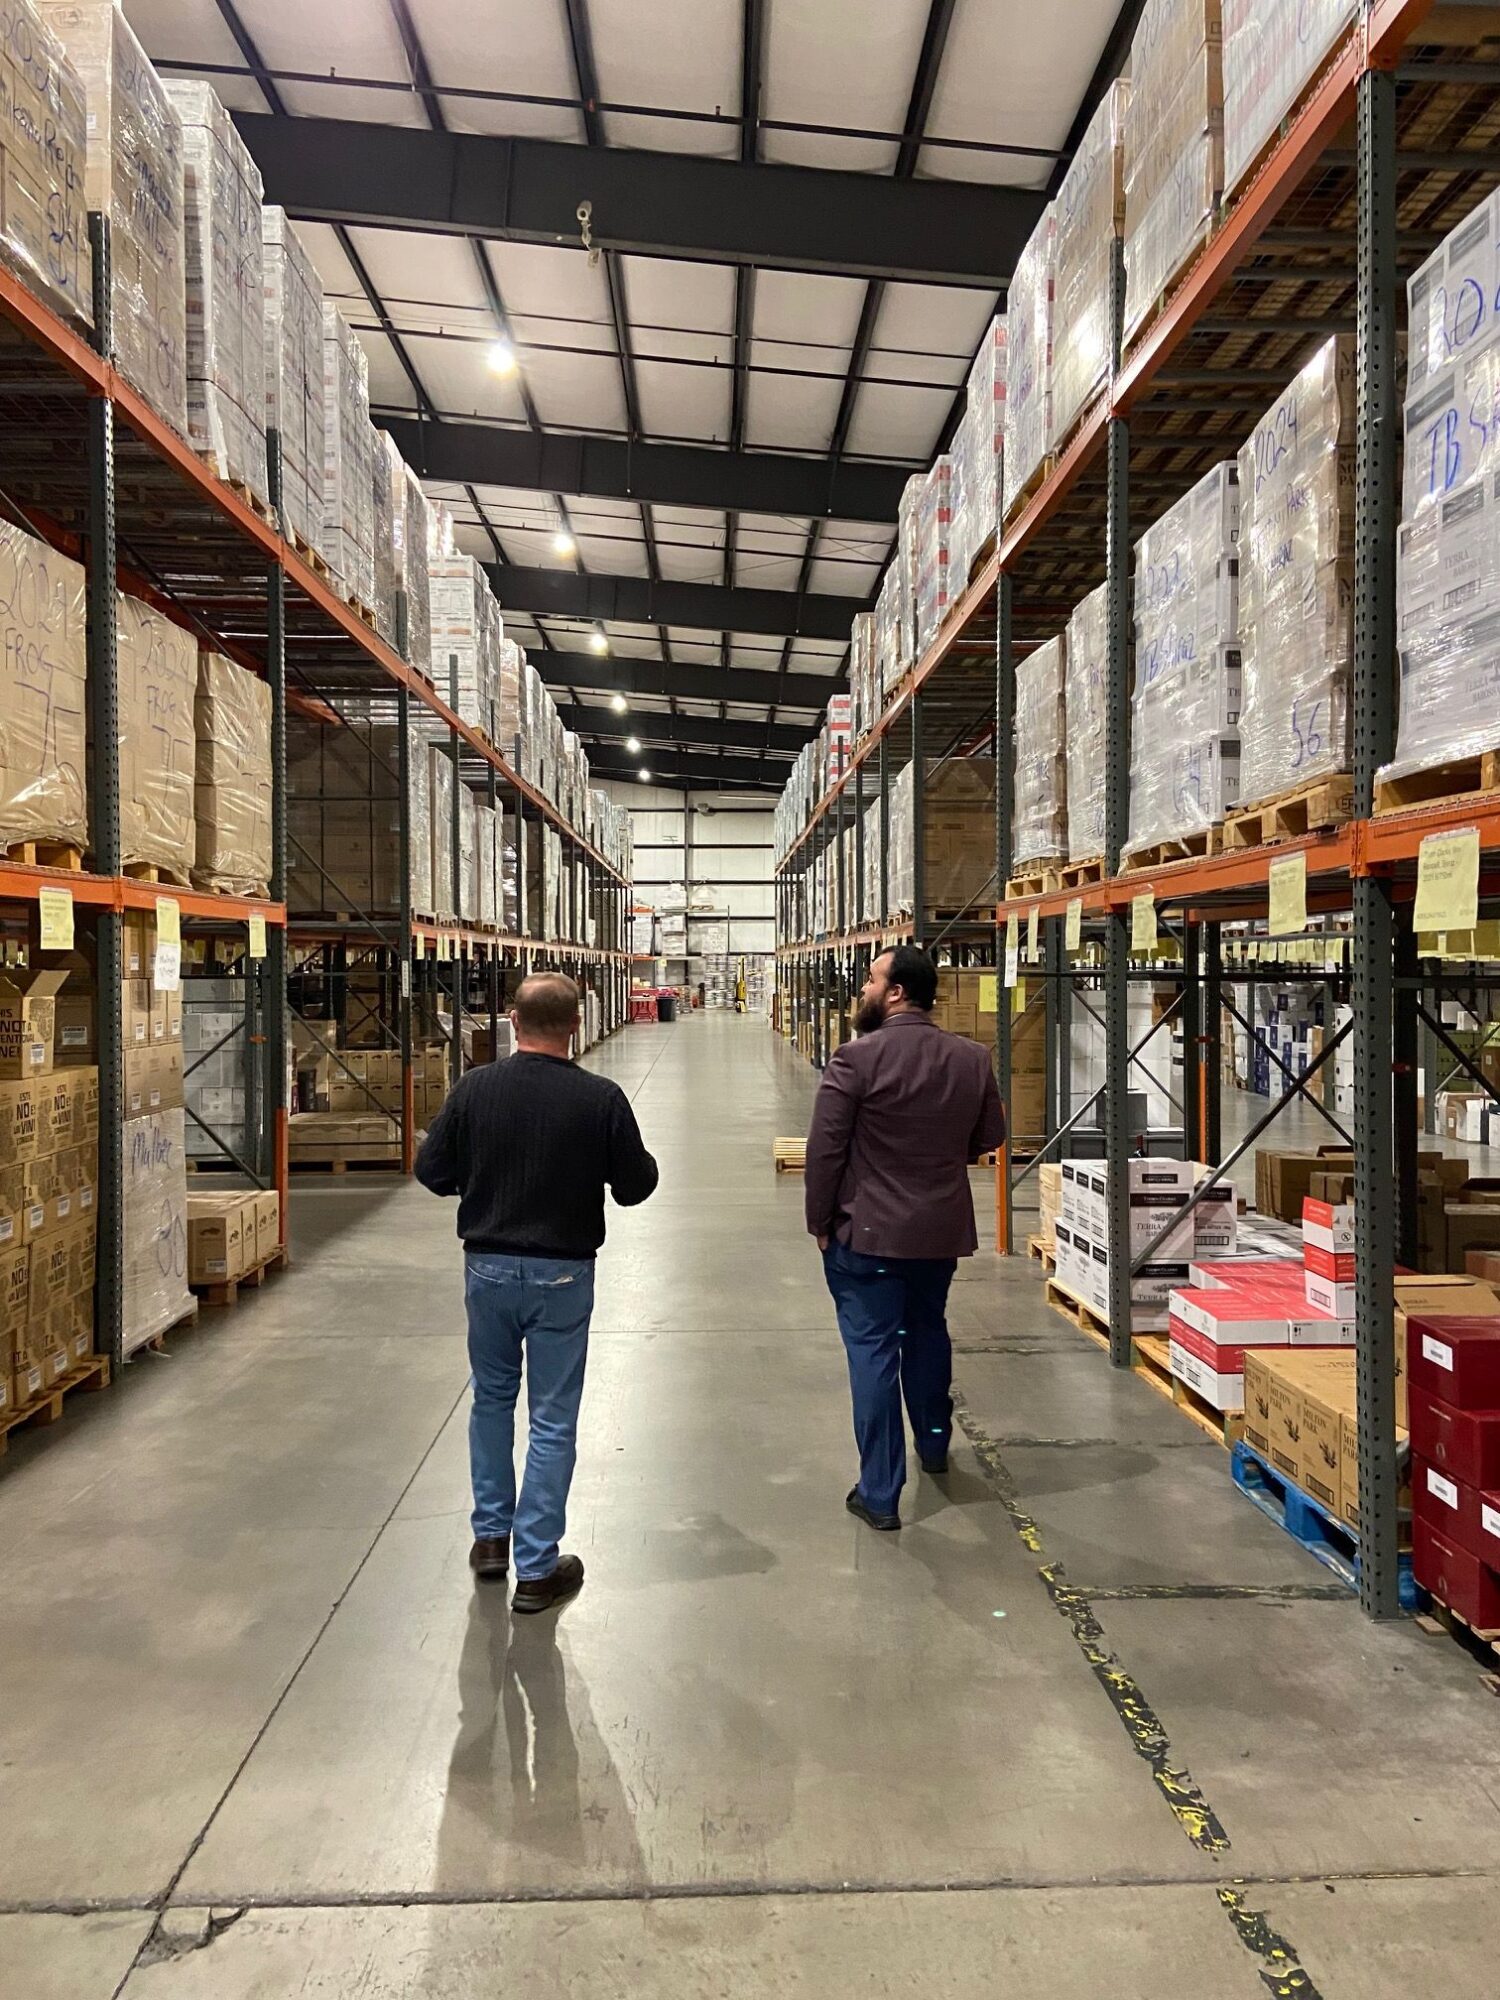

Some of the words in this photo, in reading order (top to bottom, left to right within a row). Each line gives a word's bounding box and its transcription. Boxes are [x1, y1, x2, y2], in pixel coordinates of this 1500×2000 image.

[1255, 397, 1298, 493] 2024
[1290, 691, 1321, 769] 56
[16, 1102, 30, 1121] NO
[54, 1094, 66, 1112] NO
[1303, 1407, 1327, 1429] MILTON
